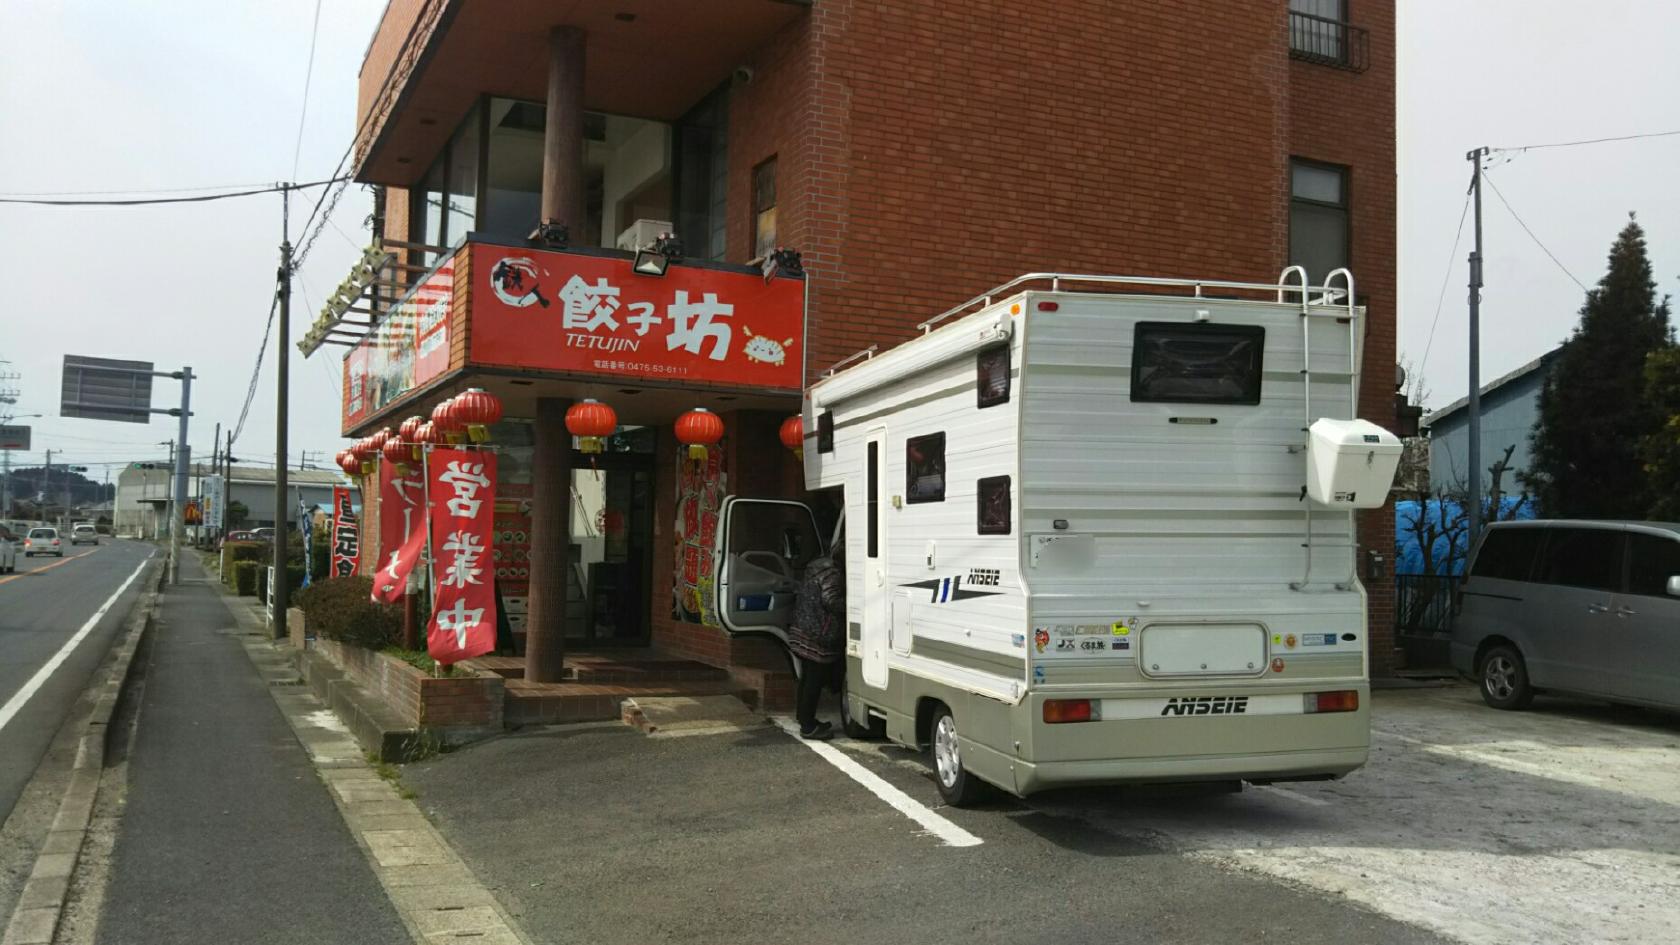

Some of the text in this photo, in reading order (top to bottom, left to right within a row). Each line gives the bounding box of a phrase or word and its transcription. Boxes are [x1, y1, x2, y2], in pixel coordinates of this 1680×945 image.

[558, 274, 734, 361] 餃子坊
[566, 333, 640, 353] TETUJIN
[437, 460, 491, 650] 営業中
